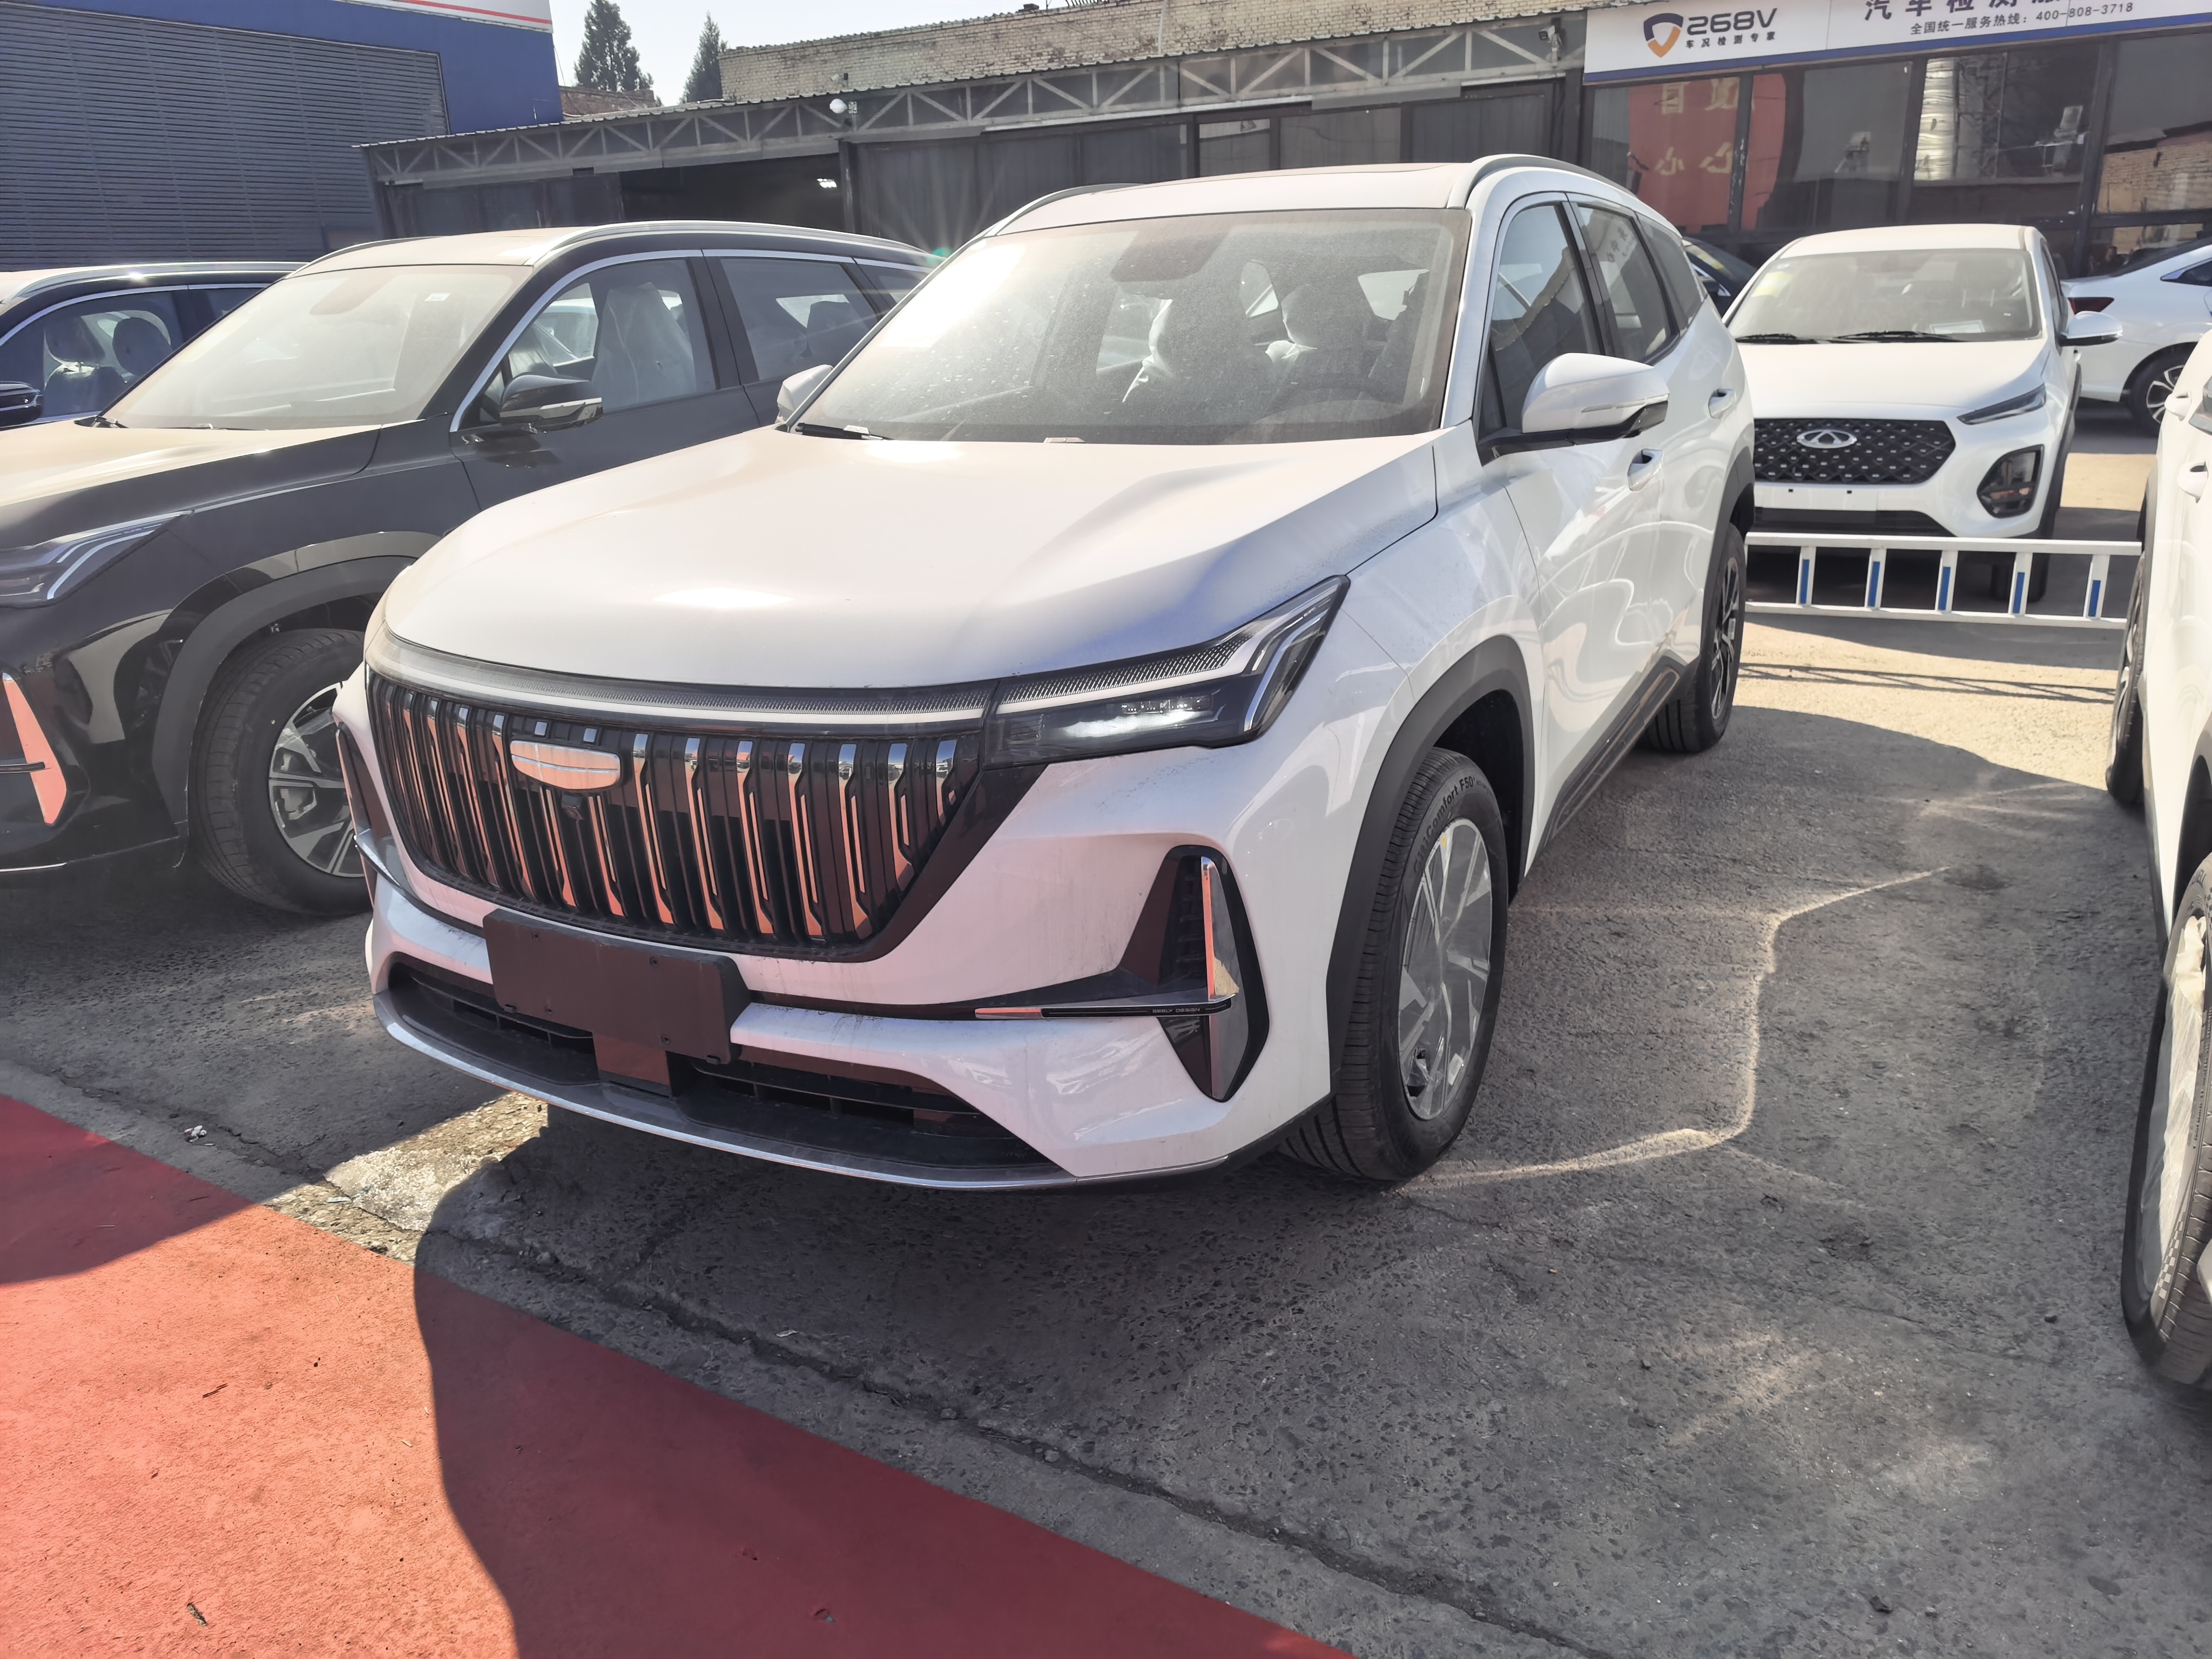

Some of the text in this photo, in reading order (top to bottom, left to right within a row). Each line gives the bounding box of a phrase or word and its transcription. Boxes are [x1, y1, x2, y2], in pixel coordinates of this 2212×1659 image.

[2036, 2, 2133, 21] 400-808-3718
[1687, 8, 1778, 36] 268V
[1685, 31, 1776, 49] 车况检测专家
